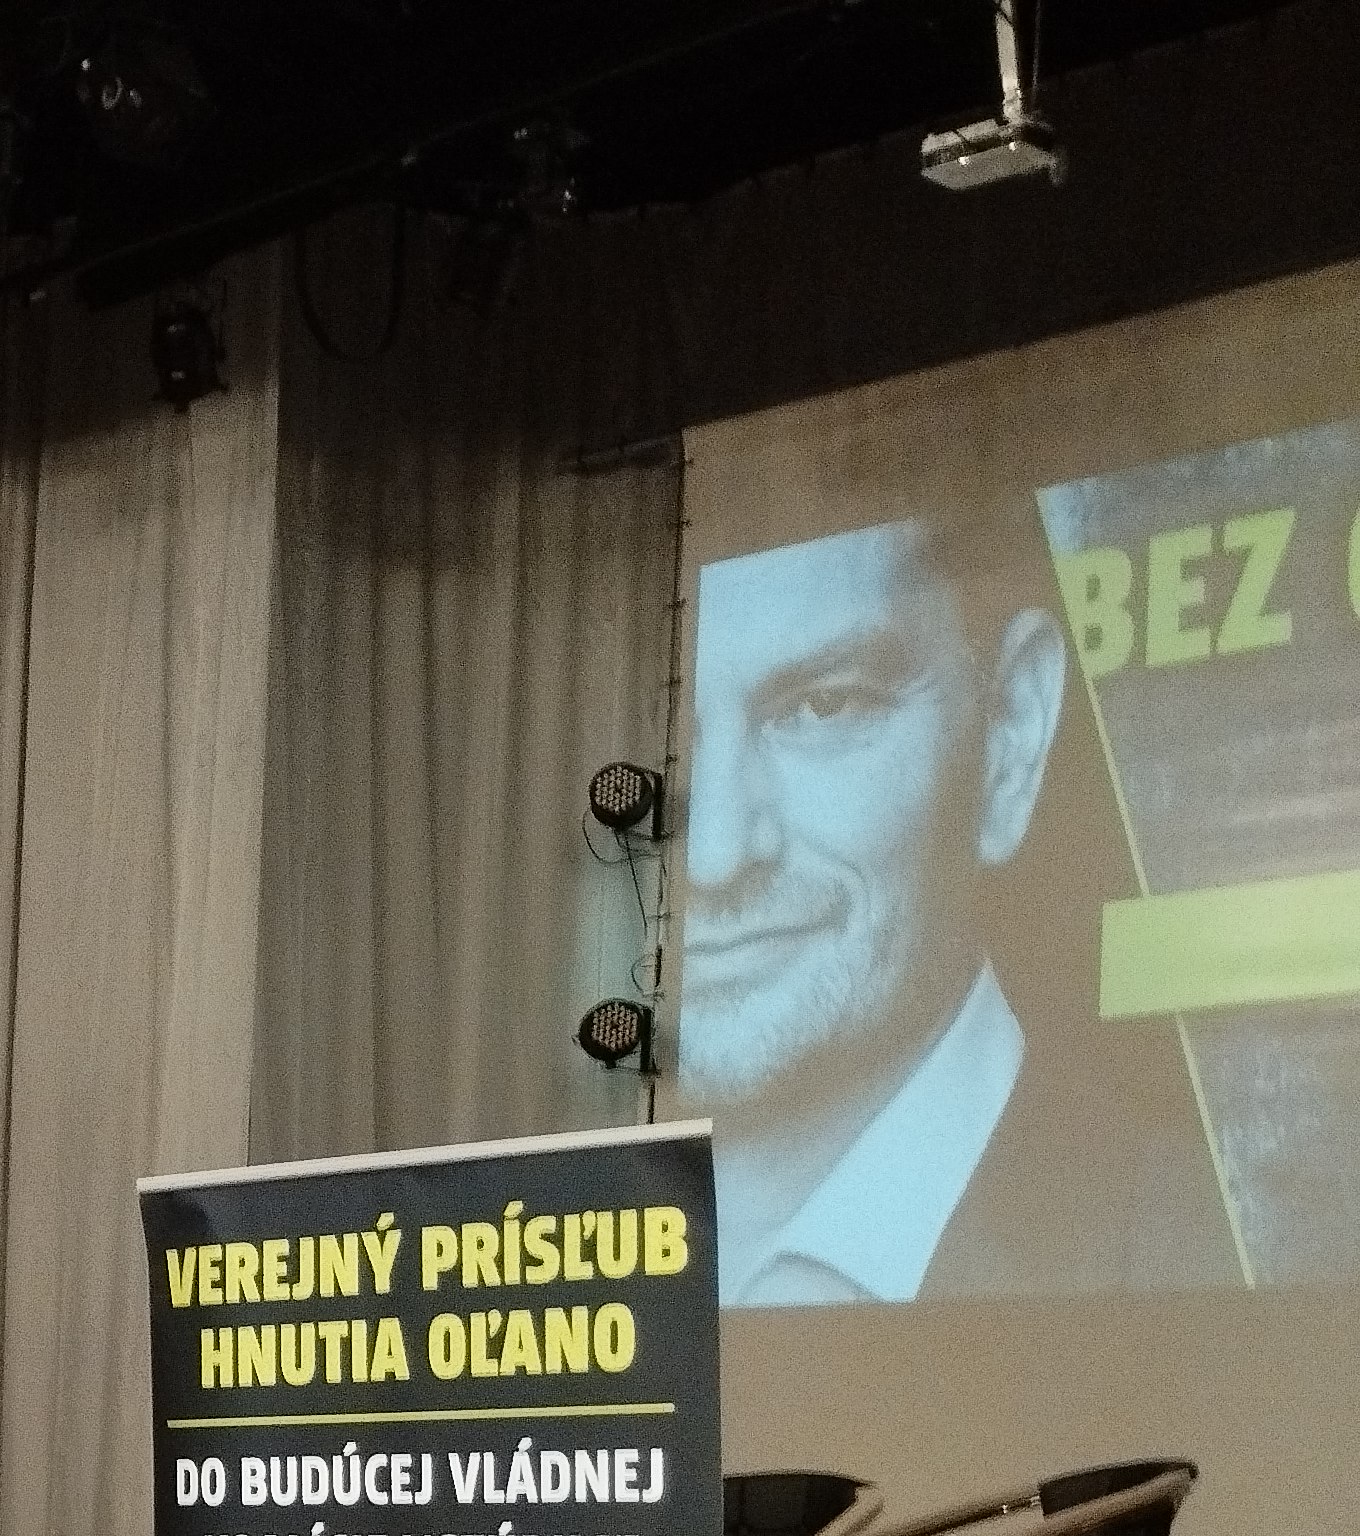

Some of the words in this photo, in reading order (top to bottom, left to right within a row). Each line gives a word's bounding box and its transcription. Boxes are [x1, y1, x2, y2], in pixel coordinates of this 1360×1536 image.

[1056, 505, 1298, 680] BEZ
[165, 1212, 402, 1309] VEREJNÝ
[421, 1201, 688, 1291] PRÍSĽUB
[201, 1317, 410, 1388] HNUTIA
[428, 1302, 636, 1380] OĽANO
[176, 1458, 226, 1506] DO
[240, 1441, 433, 1506] BUDÚCEJ
[449, 1437, 664, 1506] VLÁDNEJ
